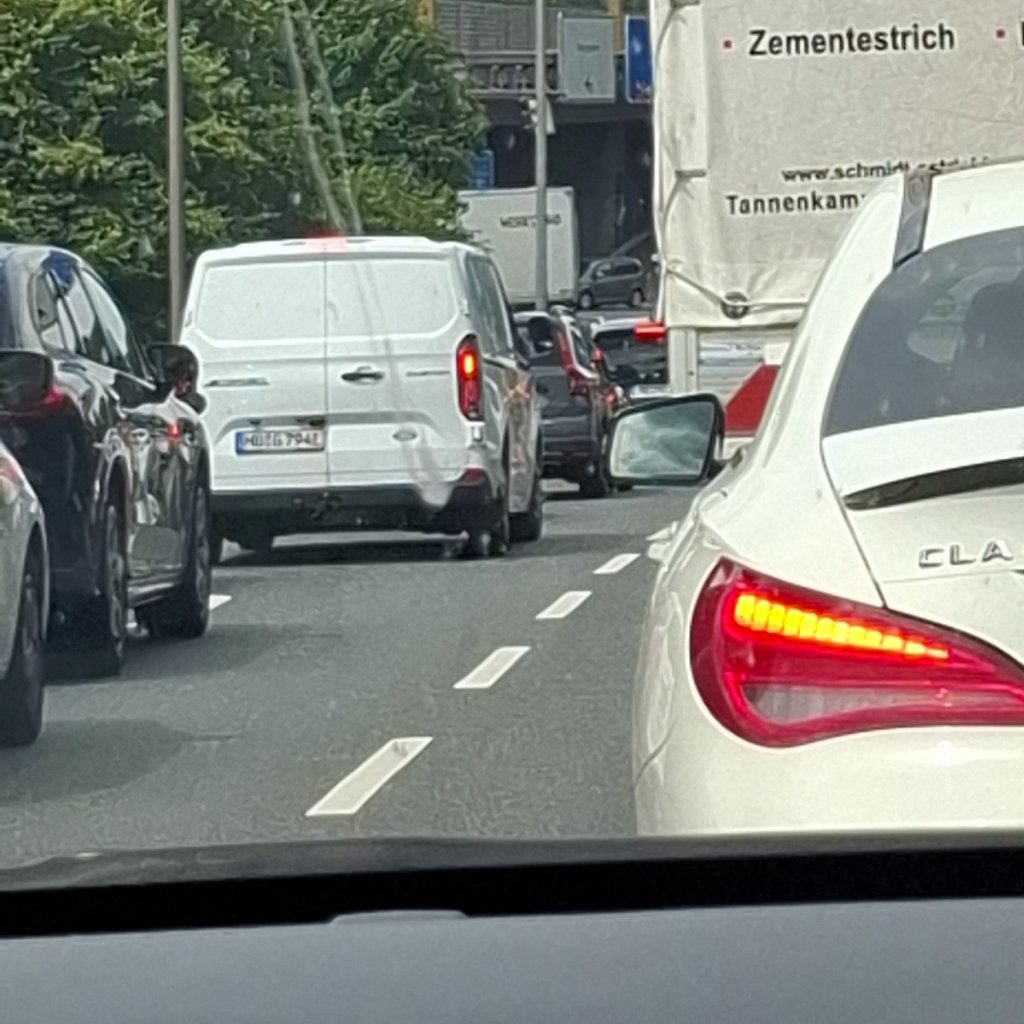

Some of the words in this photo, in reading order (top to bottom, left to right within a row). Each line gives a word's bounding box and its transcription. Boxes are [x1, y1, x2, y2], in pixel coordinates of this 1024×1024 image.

[748, 23, 956, 56] Zementestrich
[726, 190, 865, 215] Tannenkam
[918, 539, 1014, 568] CLA
